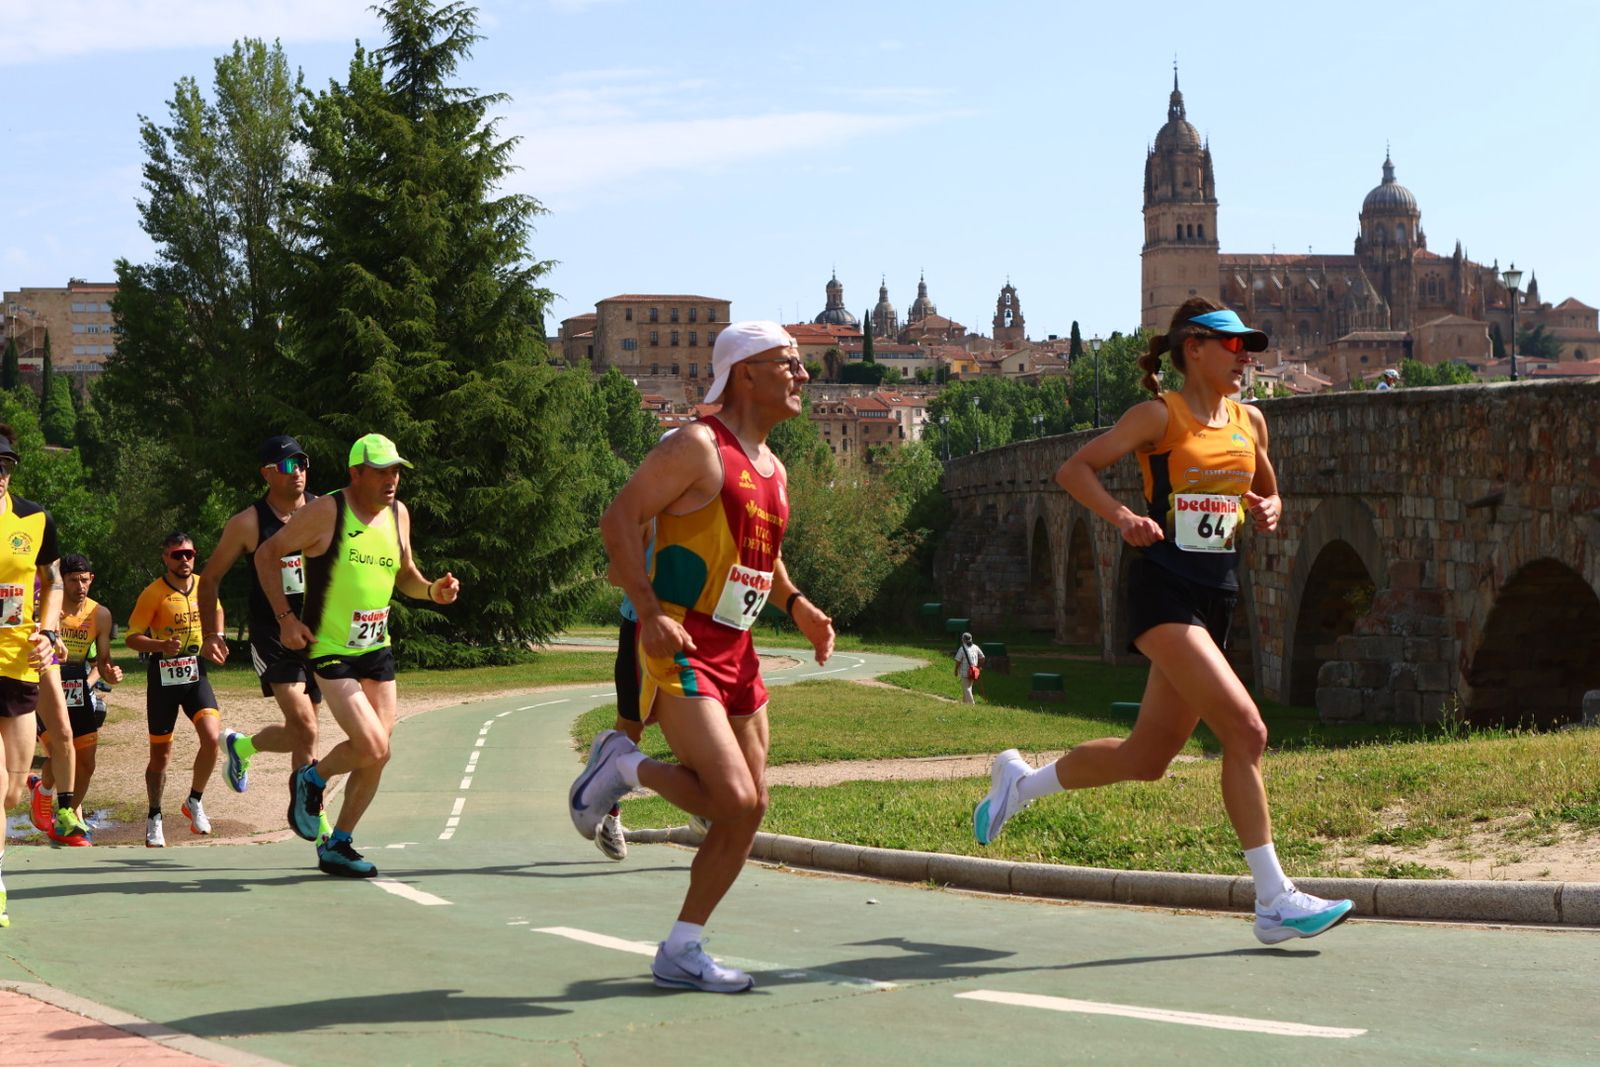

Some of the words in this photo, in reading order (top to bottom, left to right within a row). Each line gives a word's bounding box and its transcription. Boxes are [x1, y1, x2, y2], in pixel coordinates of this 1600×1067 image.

[1177, 498, 1236, 513] bedunia
[1198, 513, 1225, 539] 64
[349, 548, 373, 565] RUN
[379, 557, 394, 568] GO
[743, 590, 764, 617] 92
[358, 621, 384, 640] 213
[167, 666, 192, 679] 189
